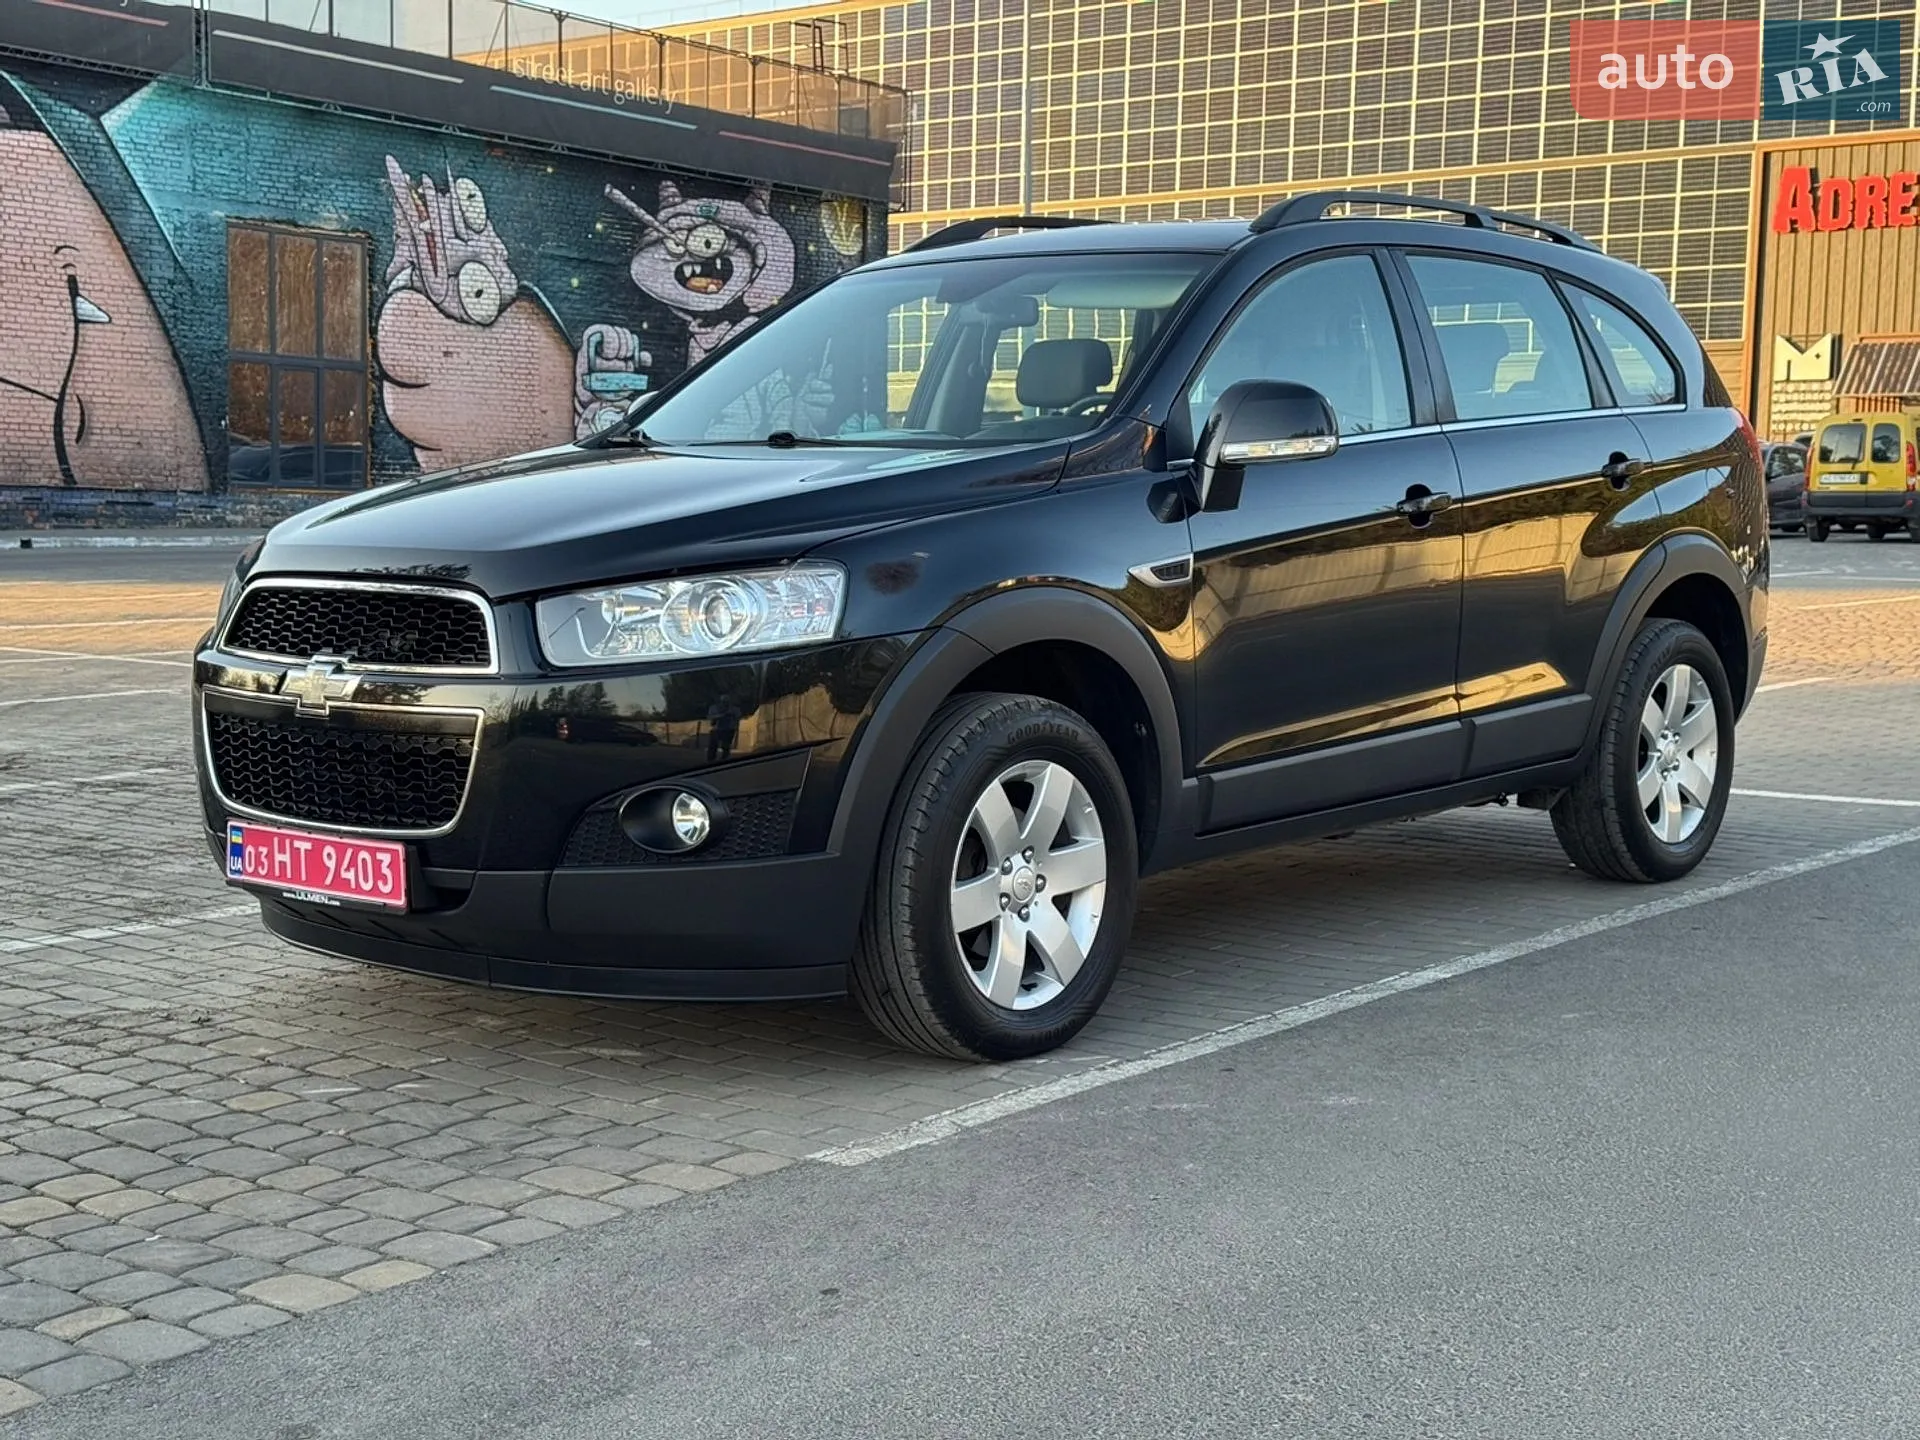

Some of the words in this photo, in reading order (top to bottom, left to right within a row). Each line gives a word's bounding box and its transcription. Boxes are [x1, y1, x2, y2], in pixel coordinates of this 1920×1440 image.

[514, 56, 574, 89] street
[580, 72, 609, 96] art
[613, 74, 678, 115] gallery
[230, 856, 243, 871] UA
[321, 844, 394, 894] 9403
